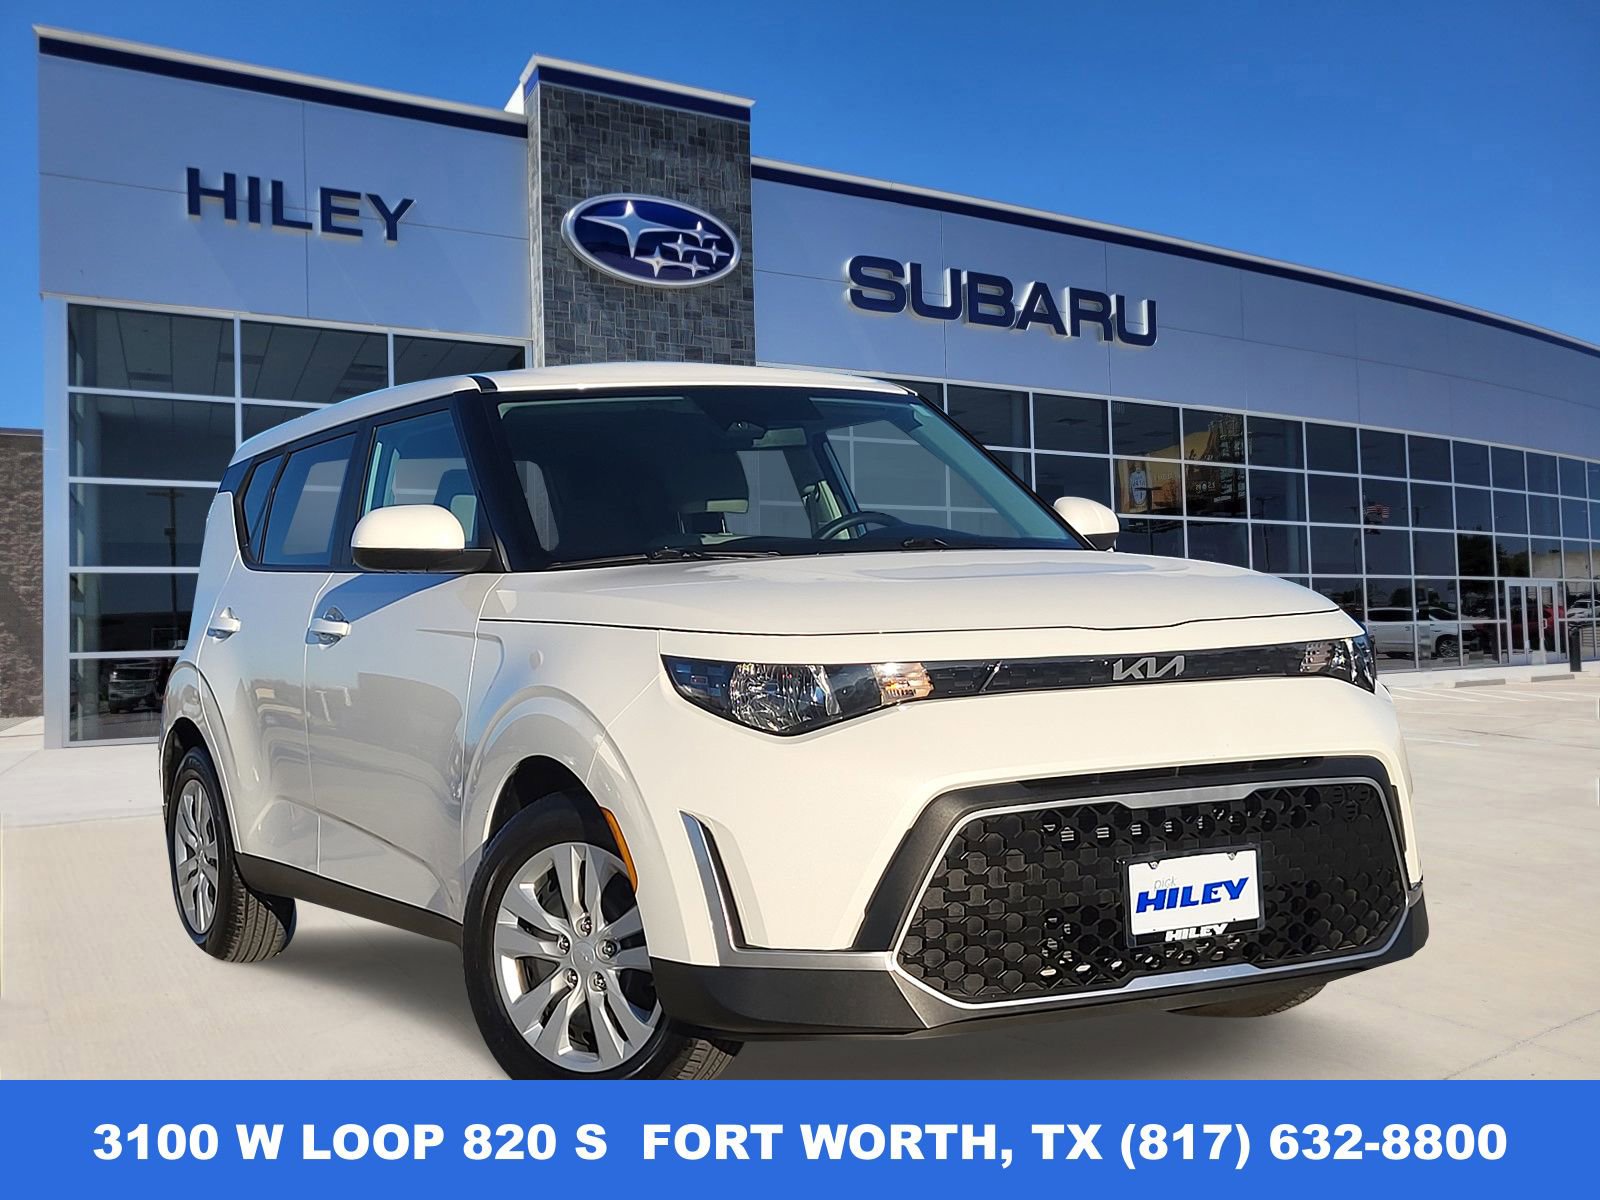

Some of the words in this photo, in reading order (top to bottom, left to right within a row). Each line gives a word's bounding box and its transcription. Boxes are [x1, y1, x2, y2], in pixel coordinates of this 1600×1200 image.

[187, 167, 415, 241] HILEY
[848, 255, 1157, 347] SUBARU
[1112, 655, 1185, 680] KIA
[1135, 877, 1249, 914] HILEY
[1164, 923, 1229, 942] HILEY
